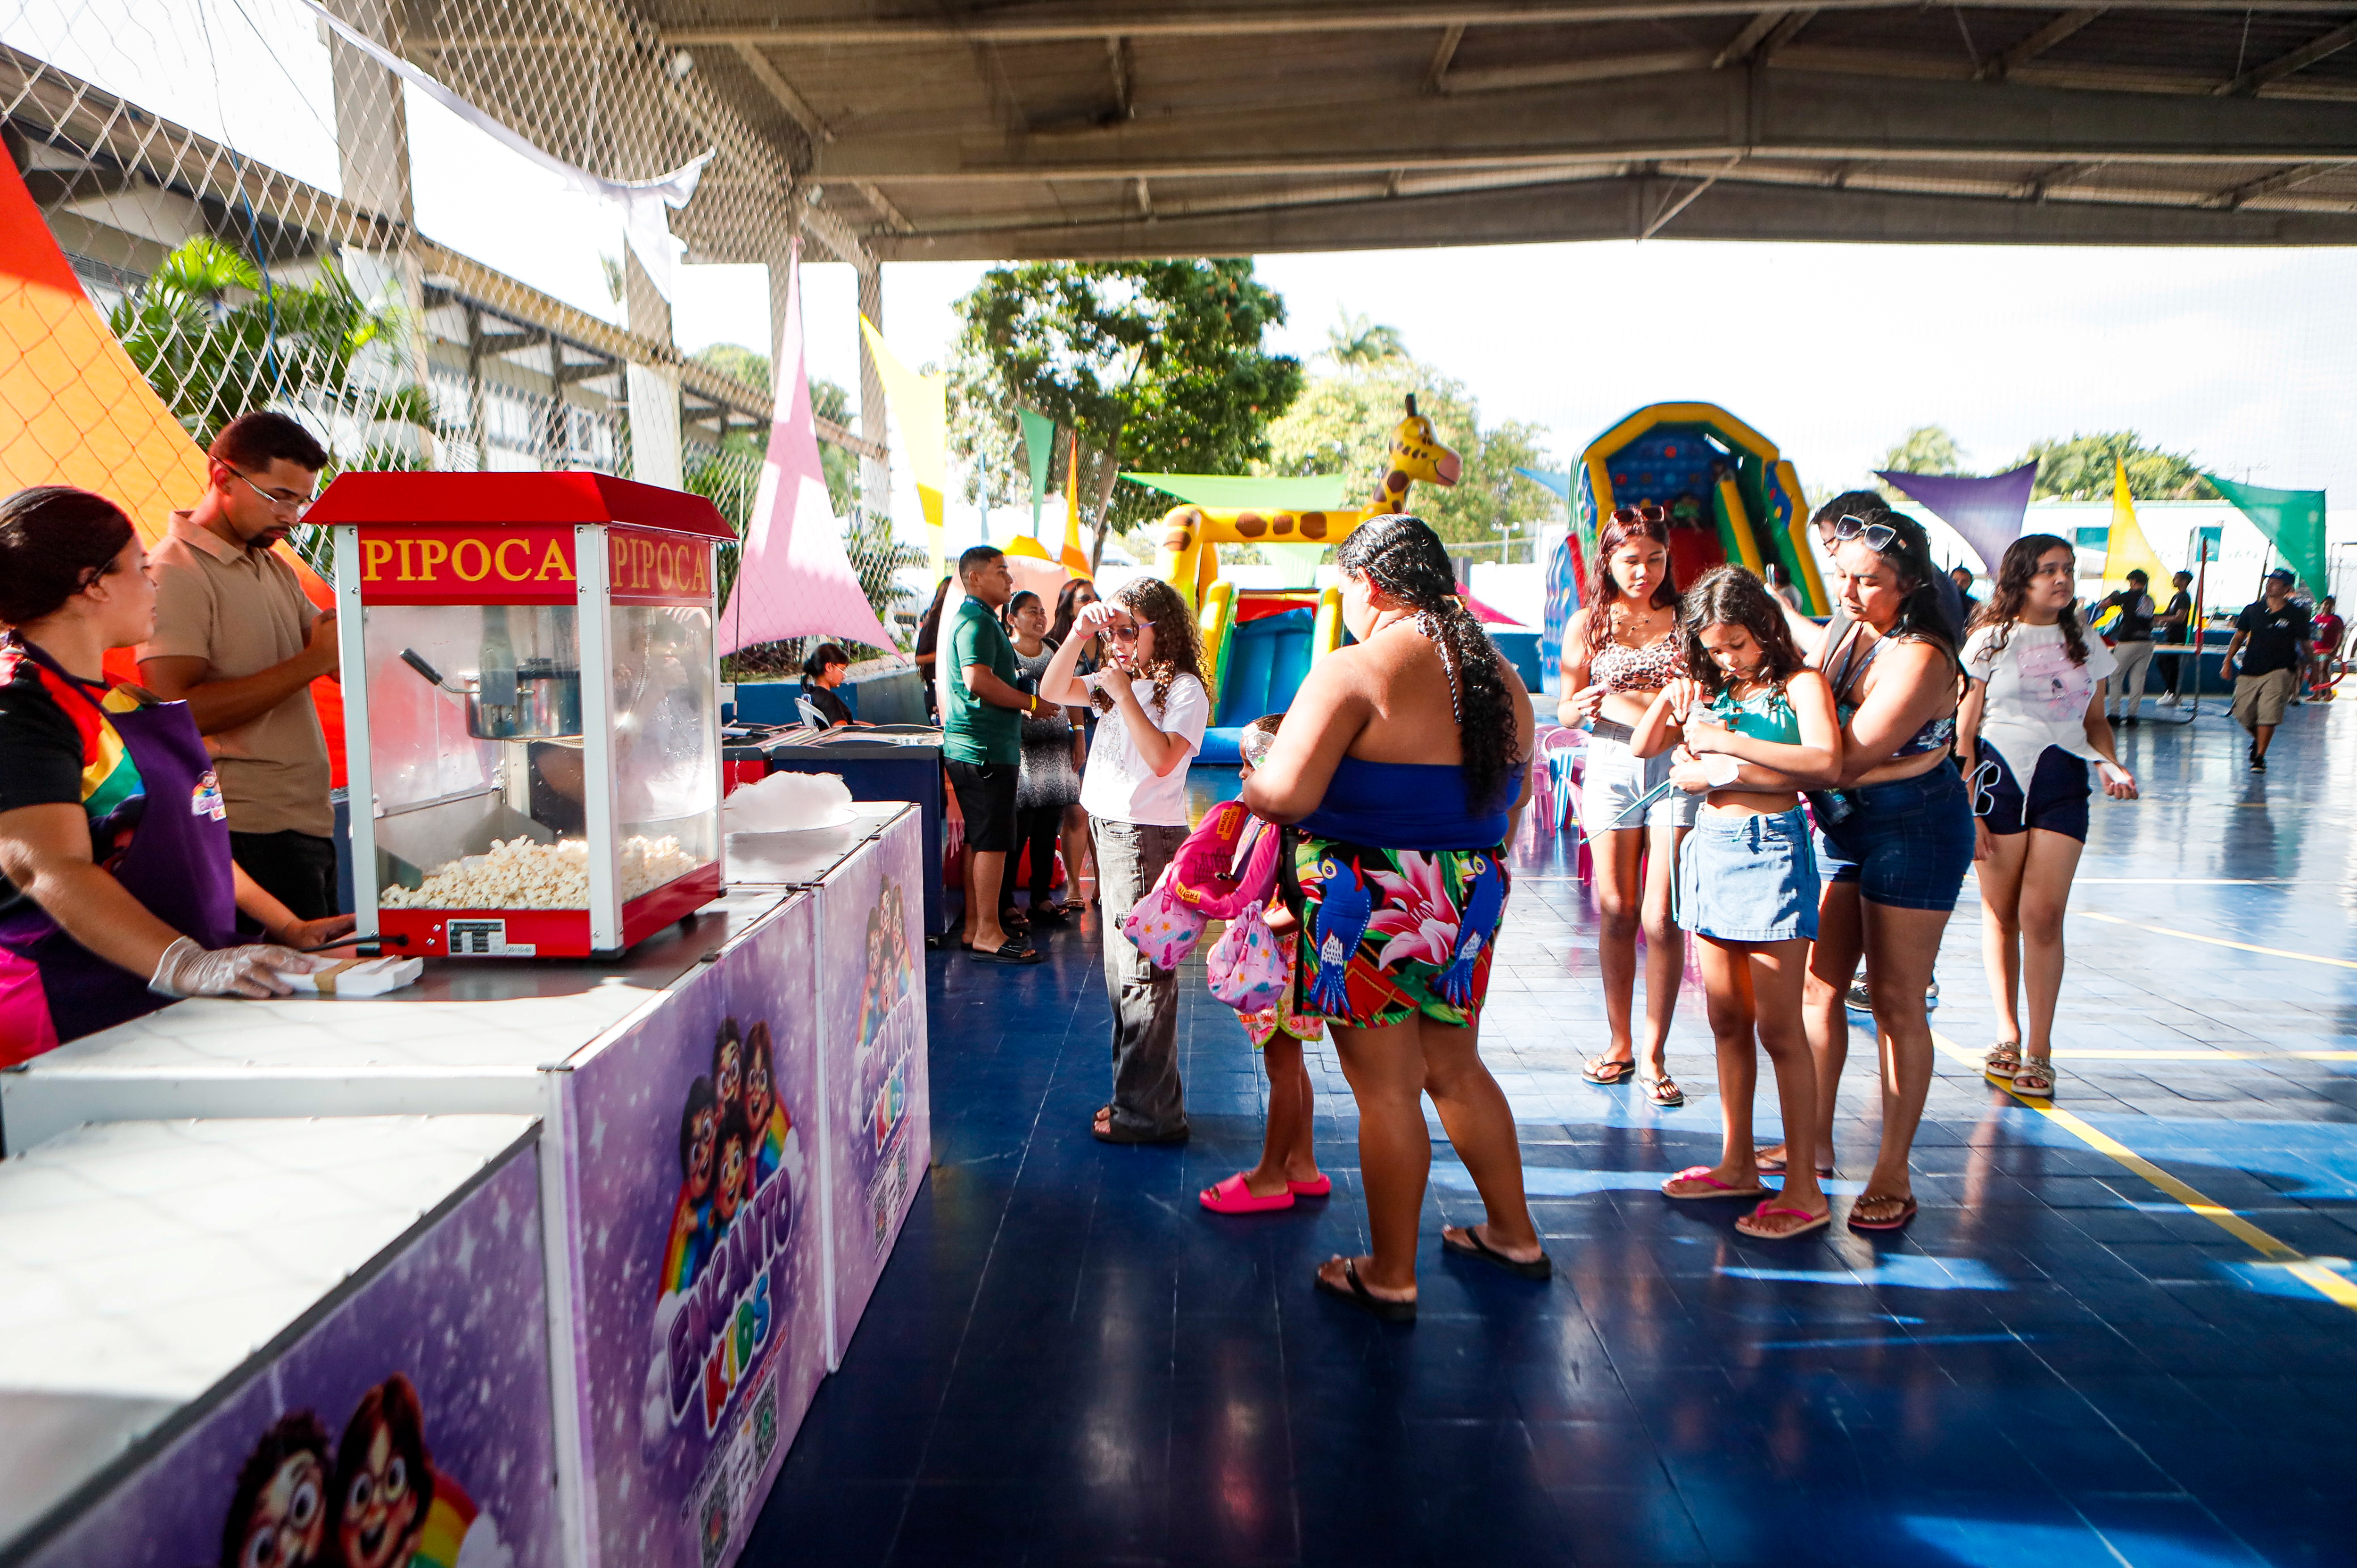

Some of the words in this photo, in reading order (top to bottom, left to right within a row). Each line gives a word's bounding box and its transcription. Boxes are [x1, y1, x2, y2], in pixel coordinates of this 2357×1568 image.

[361, 538, 576, 582] PIPOCA
[613, 535, 708, 592] PIPOCA
[1219, 811, 1230, 832] BRAÇO
[1226, 811, 1237, 834] DIREITO
[876, 1062, 905, 1151] KIDS
[668, 1166, 794, 1419] ENCANTO
[706, 1272, 770, 1430] KIDS
